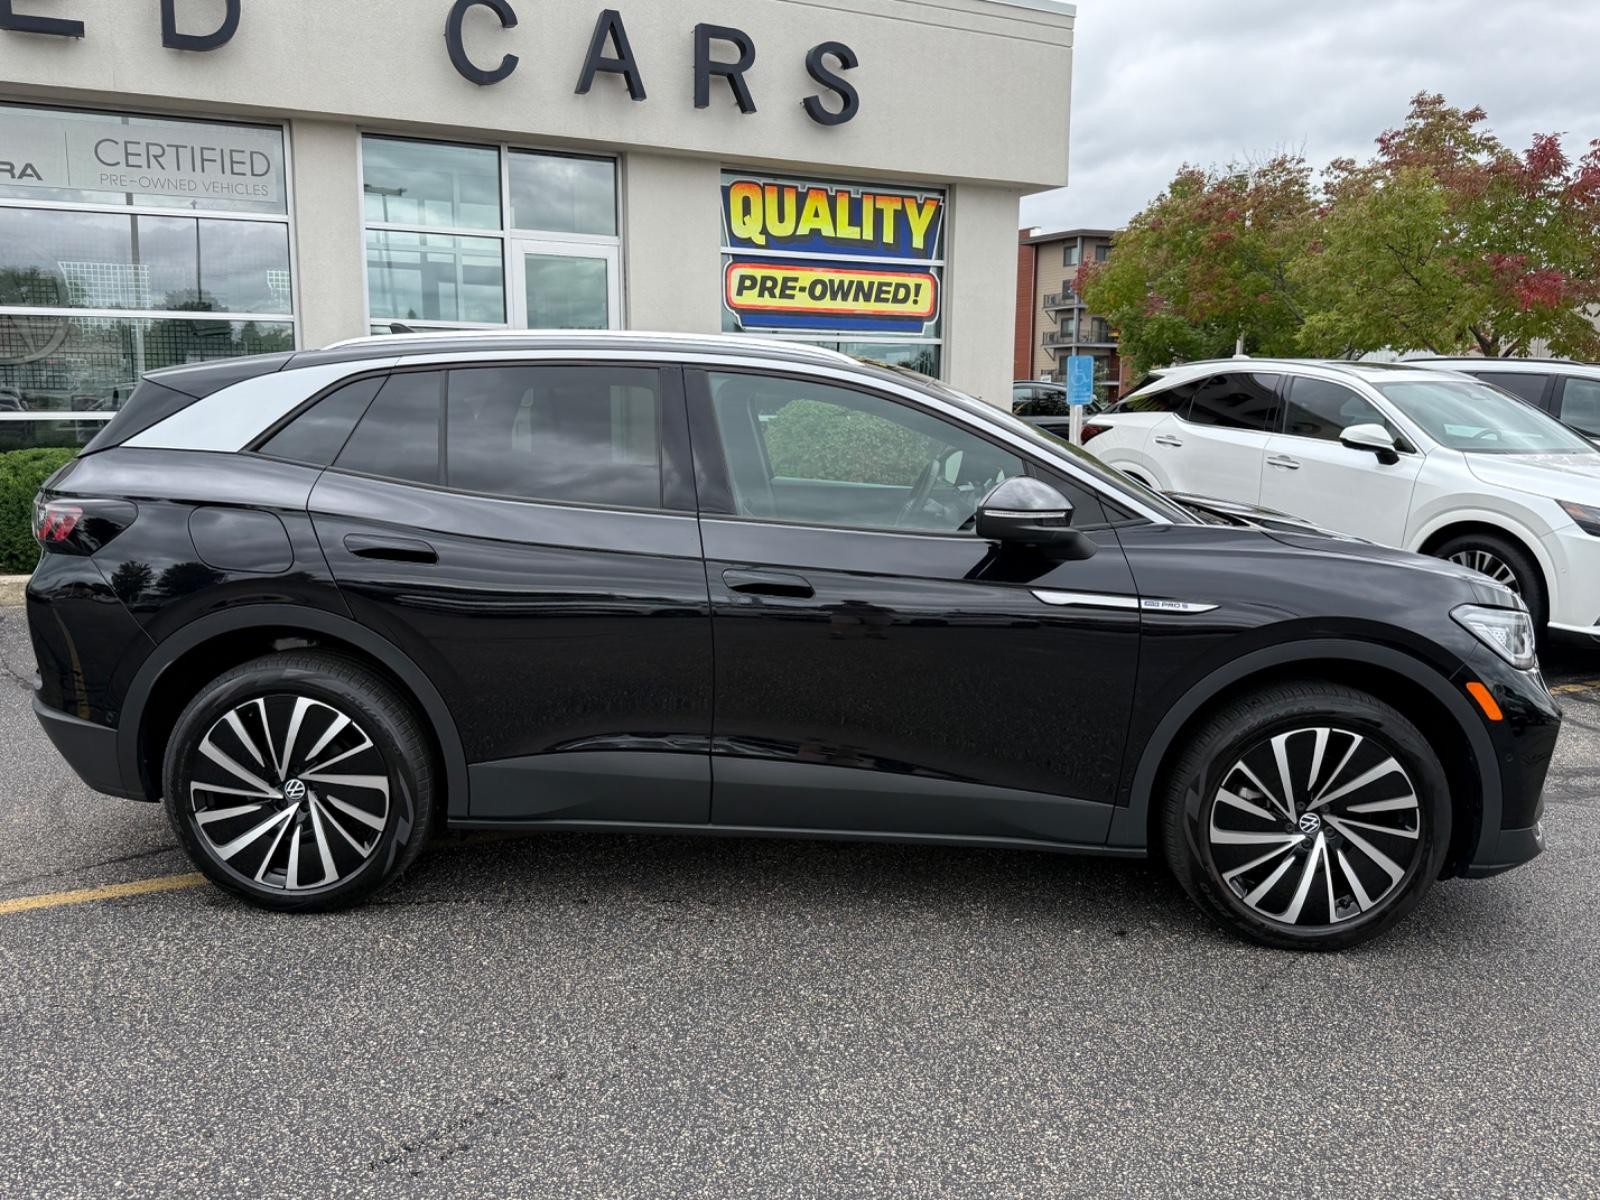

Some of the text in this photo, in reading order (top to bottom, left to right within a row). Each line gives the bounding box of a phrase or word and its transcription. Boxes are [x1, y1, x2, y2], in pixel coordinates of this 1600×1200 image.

[445, 0, 859, 126] CARS
[94, 138, 271, 177] CERTIFIED
[100, 173, 269, 197] PRE-OWNED VEHICLES
[729, 181, 939, 249] QUALITY
[735, 274, 922, 305] PRE-OWNED!
